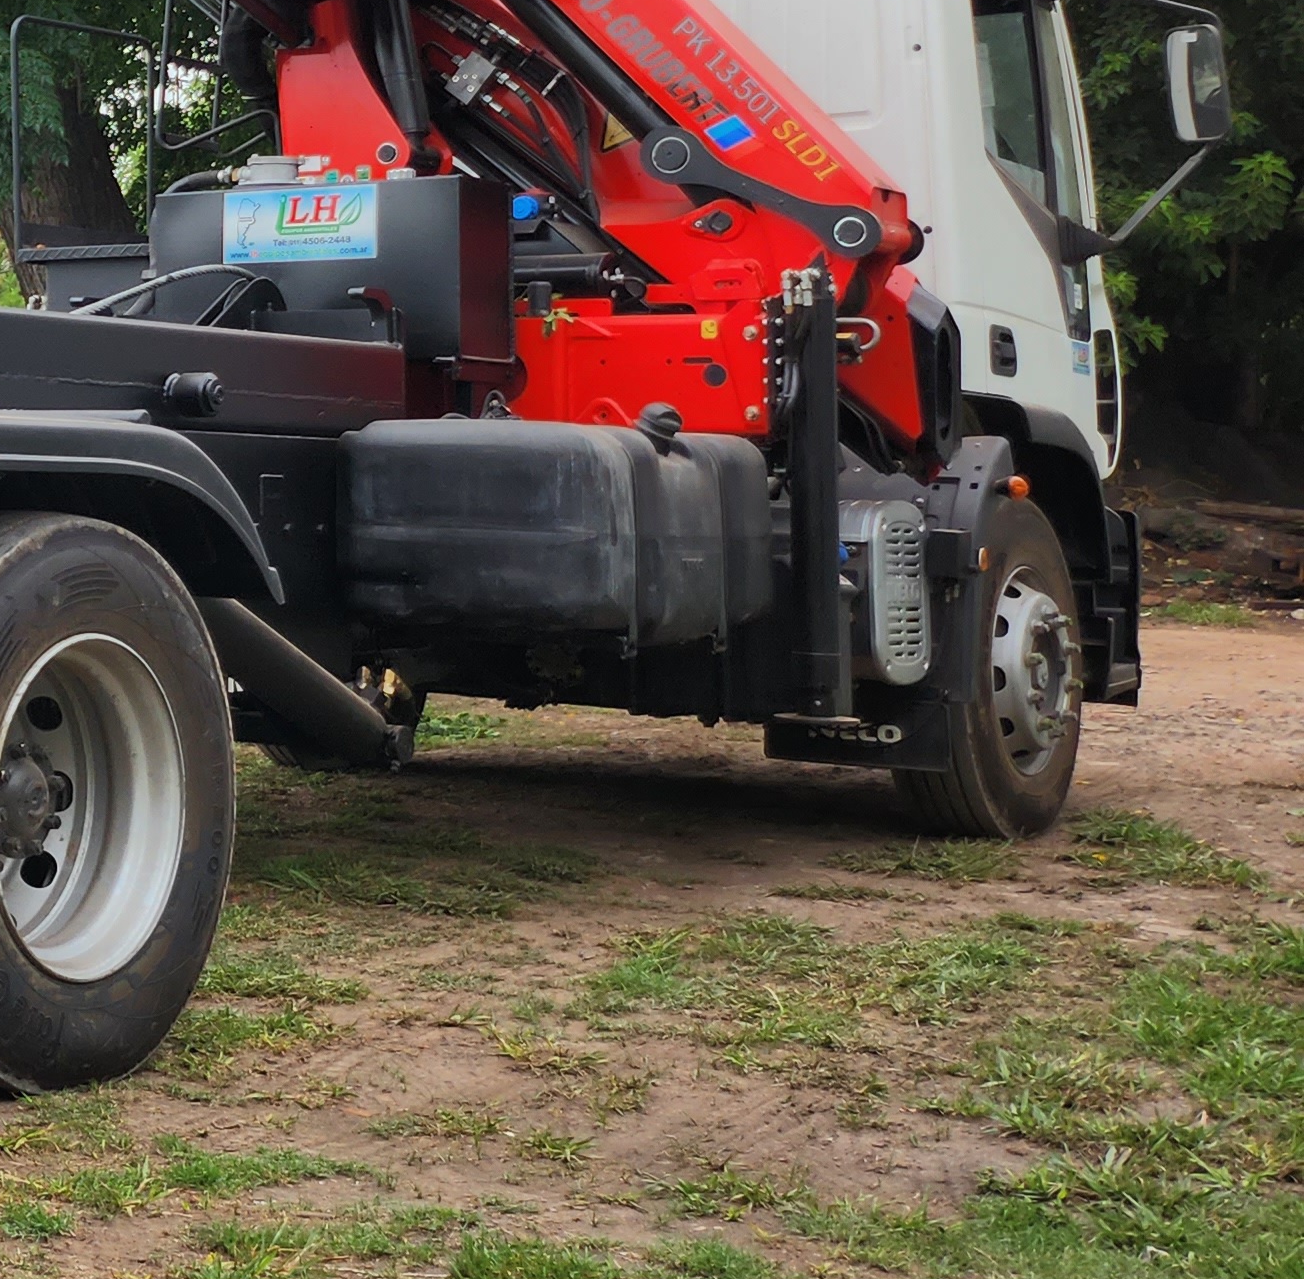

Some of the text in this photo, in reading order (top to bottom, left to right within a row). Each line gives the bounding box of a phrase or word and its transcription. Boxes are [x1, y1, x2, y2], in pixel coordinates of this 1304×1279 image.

[672, 16, 841, 182] PK 13.501 SLD1
[285, 193, 341, 225] LH
